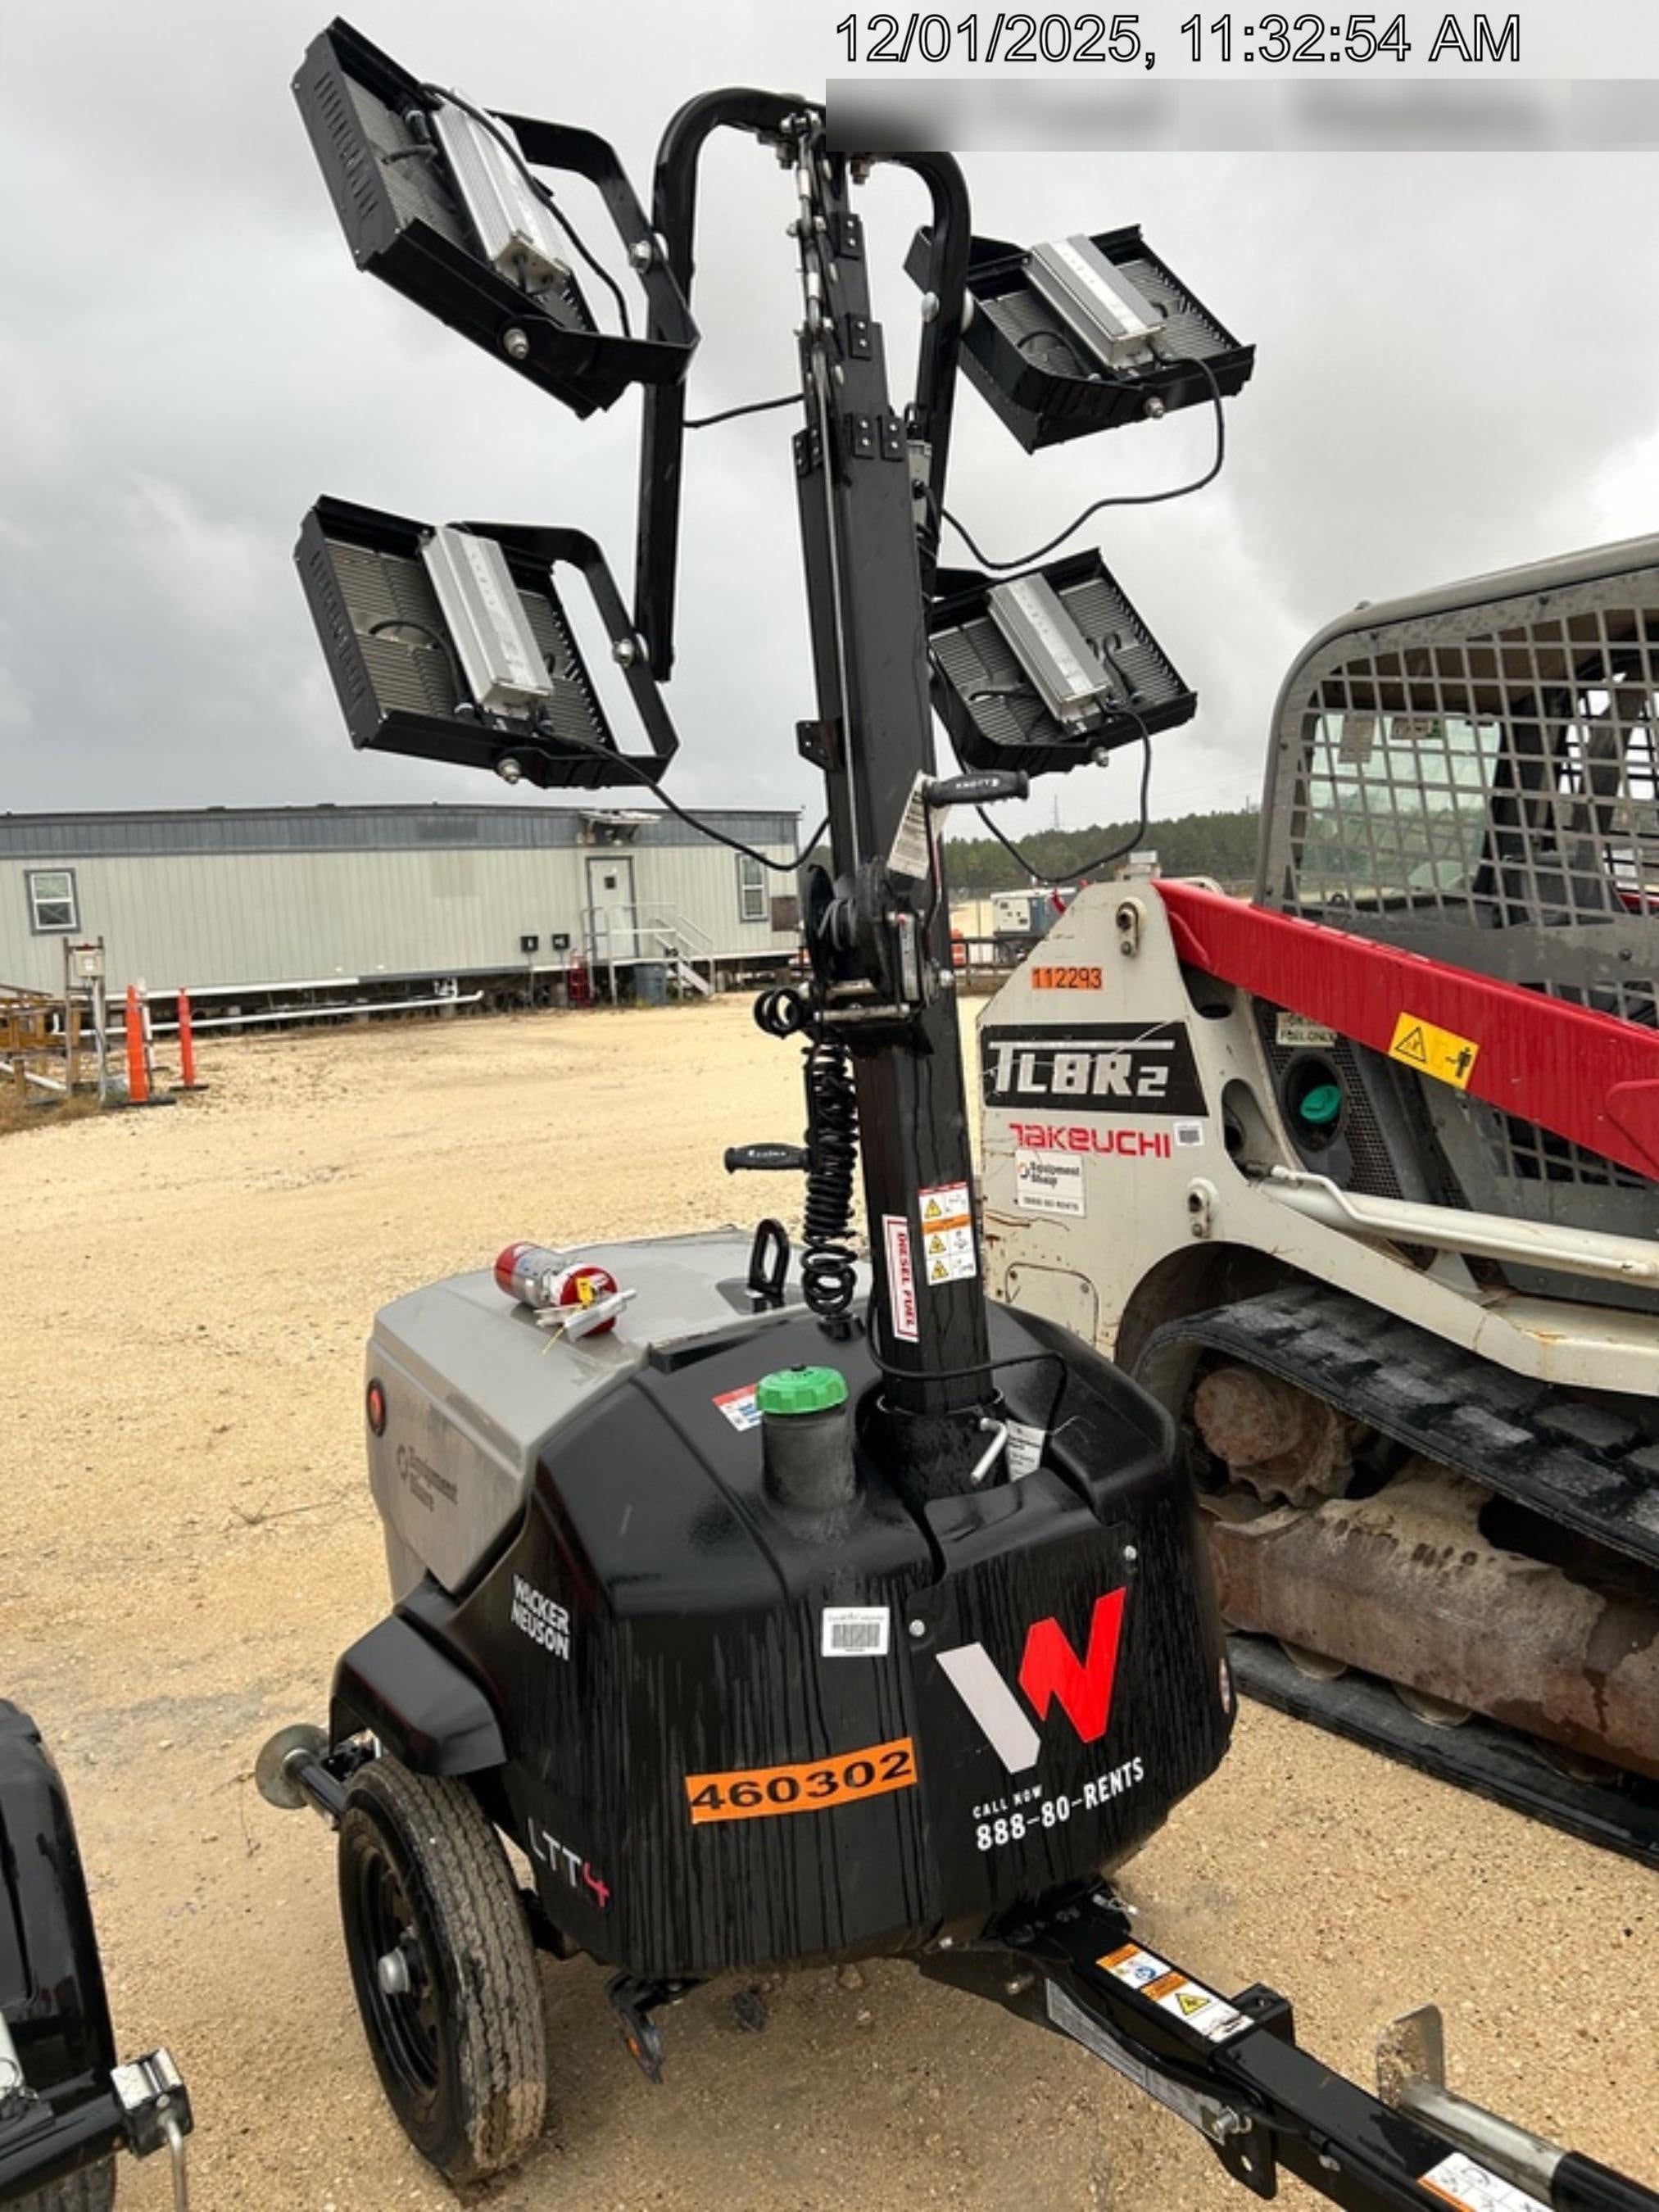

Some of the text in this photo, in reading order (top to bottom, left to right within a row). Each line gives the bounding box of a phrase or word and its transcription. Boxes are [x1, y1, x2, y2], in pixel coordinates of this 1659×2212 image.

[1032, 968, 1102, 989] 112293
[897, 1232, 915, 1327] DIESEL FUEL
[511, 1599, 569, 1661] NEUSON
[512, 1574, 570, 1635] WACKER
[691, 1750, 913, 1809] 460302
[972, 1784, 1043, 1820] CALL NOW
[976, 1756, 1145, 1851] 888-80-RENTS
[528, 1815, 610, 1908] LTT4
